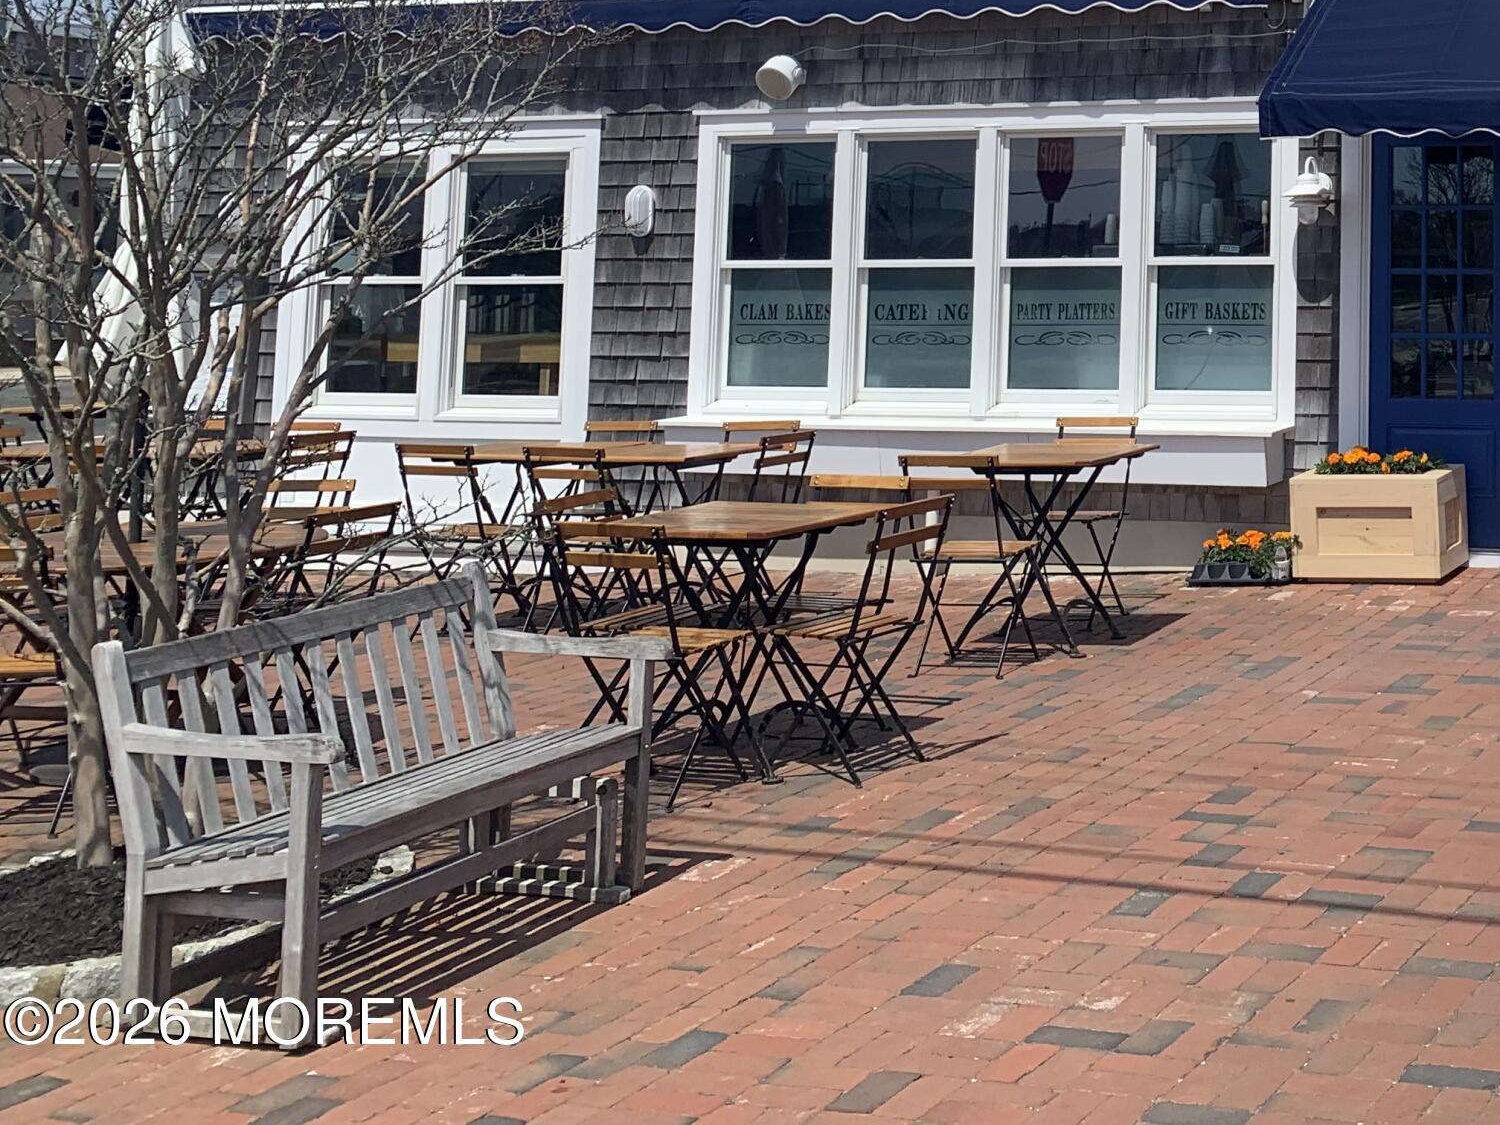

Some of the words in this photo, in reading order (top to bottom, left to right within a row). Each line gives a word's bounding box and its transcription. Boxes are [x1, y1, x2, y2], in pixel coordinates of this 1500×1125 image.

[740, 303, 779, 321] CLAM
[786, 303, 831, 321] BAKES
[1016, 303, 1052, 321] PARTY
[1057, 302, 1116, 321] PLATTERS
[1165, 302, 1199, 320] GIFT
[1205, 301, 1267, 321] BASKETS
